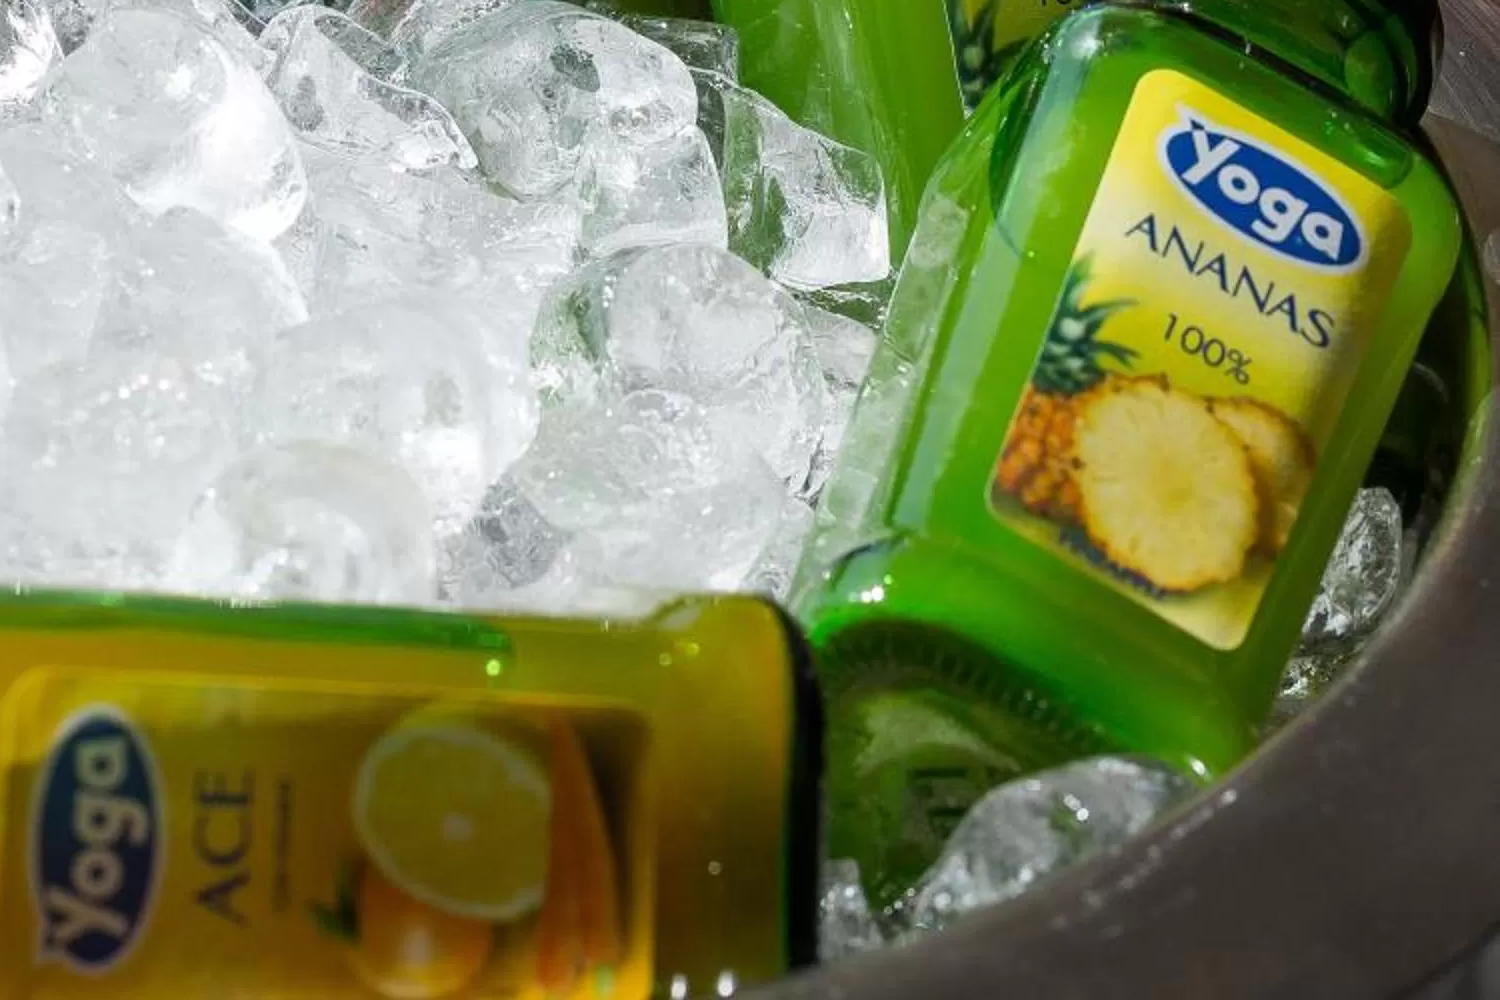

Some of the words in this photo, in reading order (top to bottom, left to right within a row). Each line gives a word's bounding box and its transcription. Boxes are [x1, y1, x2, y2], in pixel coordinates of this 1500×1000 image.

[1183, 124, 1345, 261] Yoga
[1125, 213, 1337, 349] ANANAS
[1161, 312, 1253, 385] 100%
[45, 738, 149, 940] Yoga
[194, 768, 255, 930] ACE
